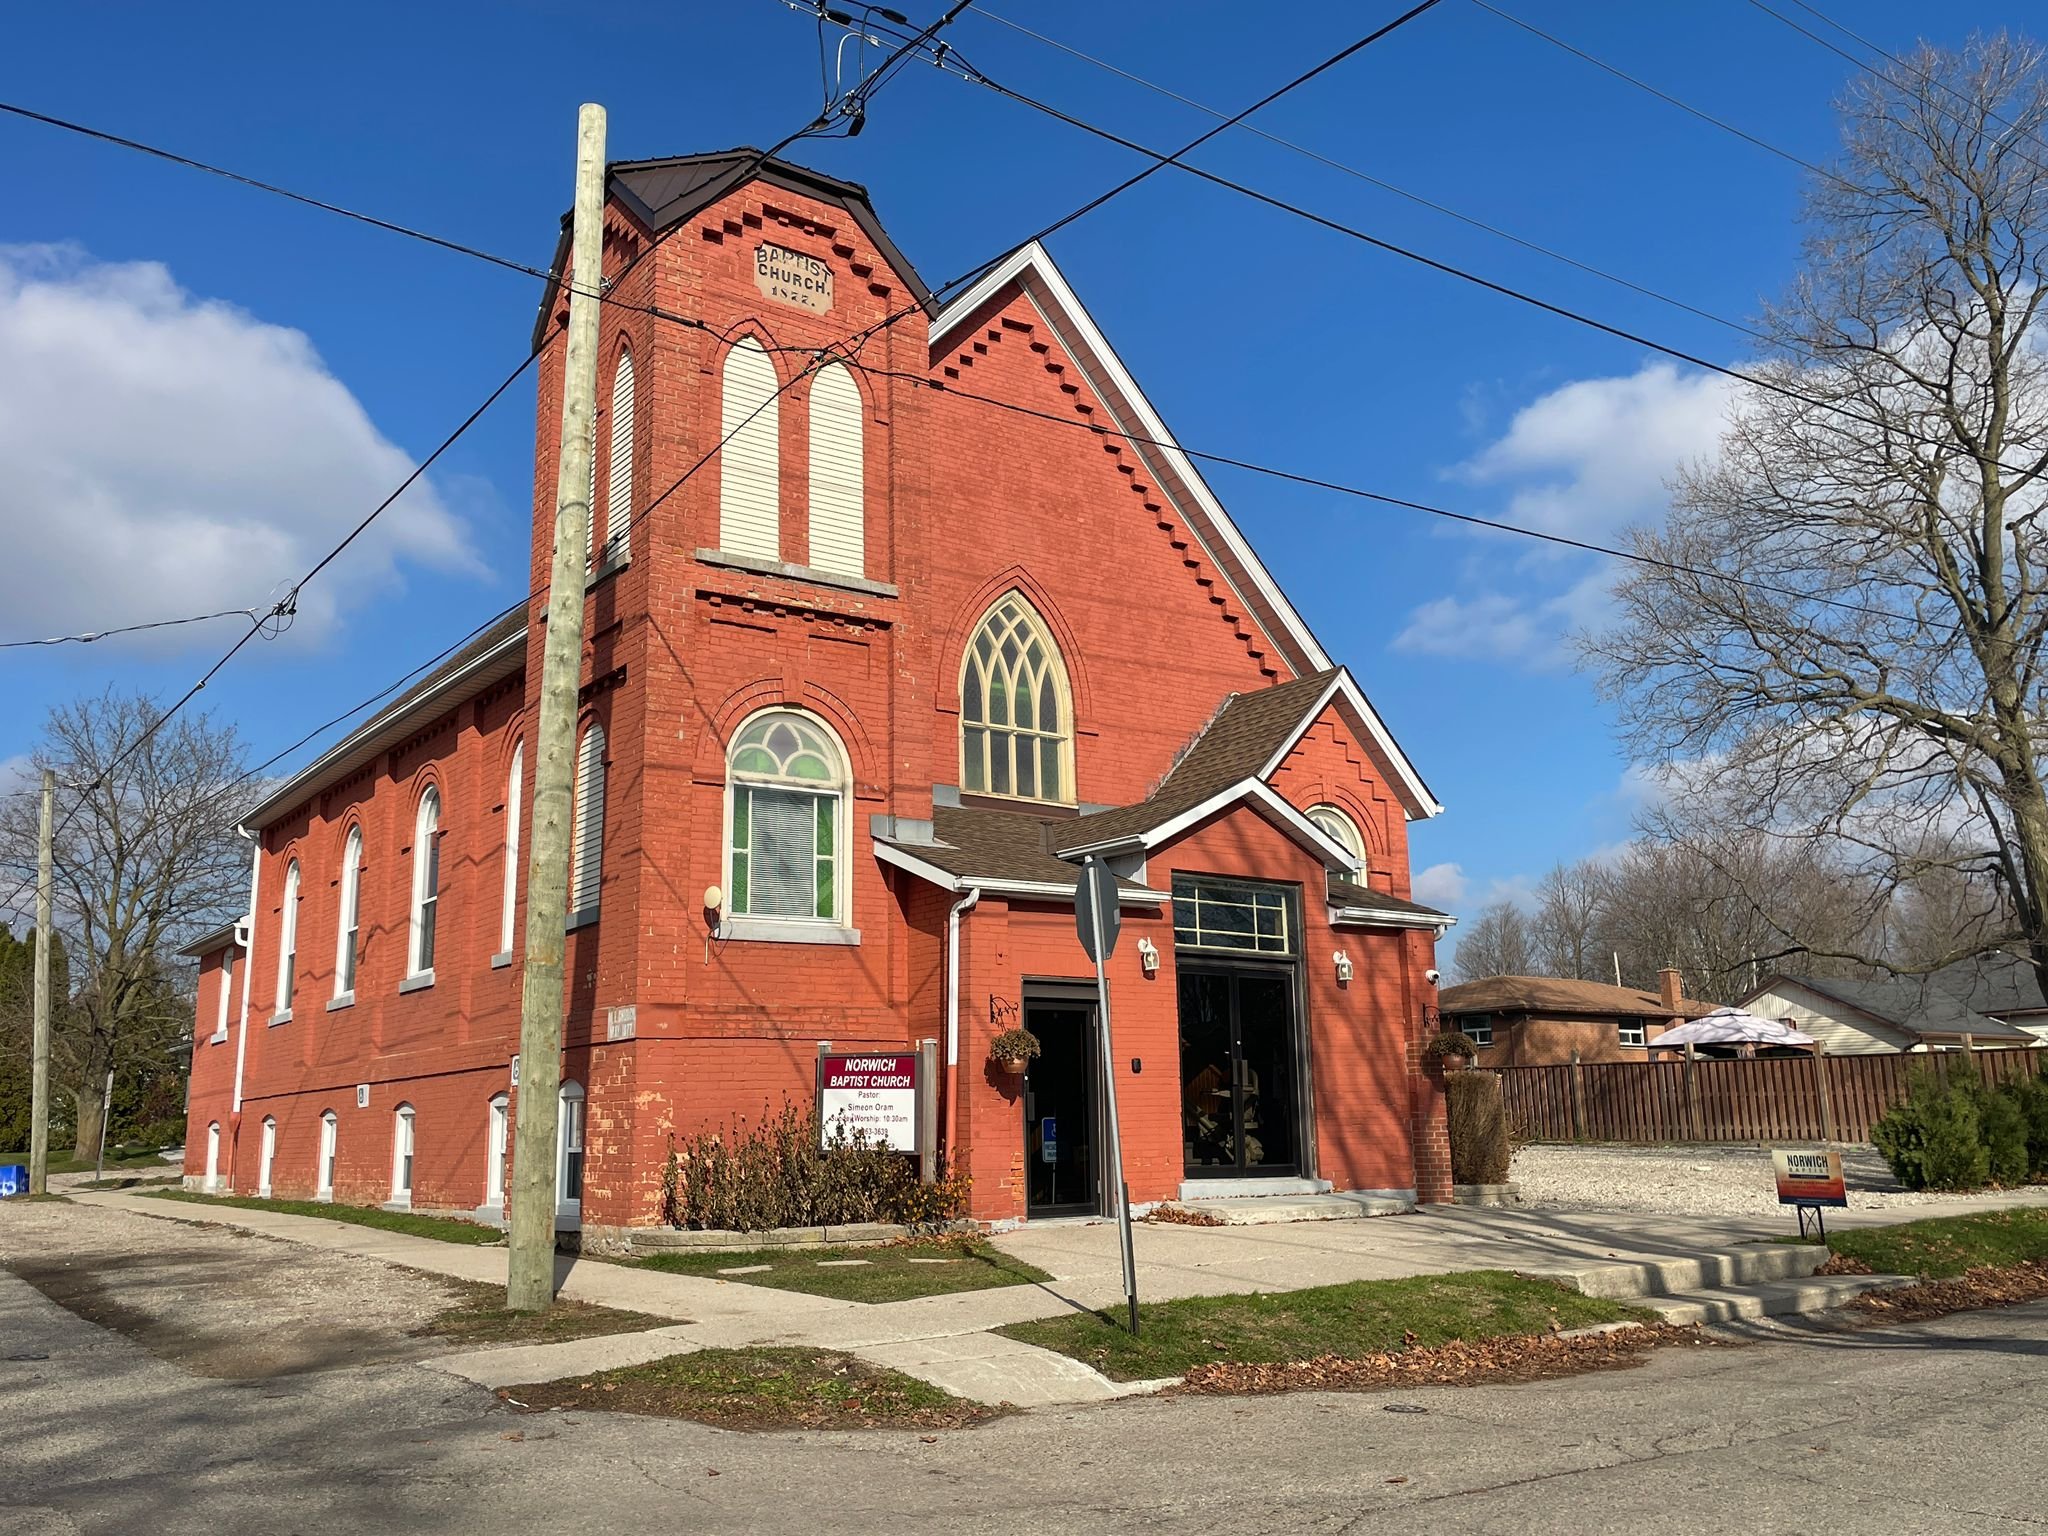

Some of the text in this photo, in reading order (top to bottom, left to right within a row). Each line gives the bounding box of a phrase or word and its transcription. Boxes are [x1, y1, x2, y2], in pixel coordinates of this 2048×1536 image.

[757, 248, 831, 283] BAPTIST
[758, 263, 830, 297] CHURCH.
[845, 1058, 897, 1072] NORWICH
[830, 1075, 910, 1087] BAPTIST CHURCH
[848, 1103, 894, 1112] Simeon Oram
[1787, 1155, 1828, 1168] NORWICH
